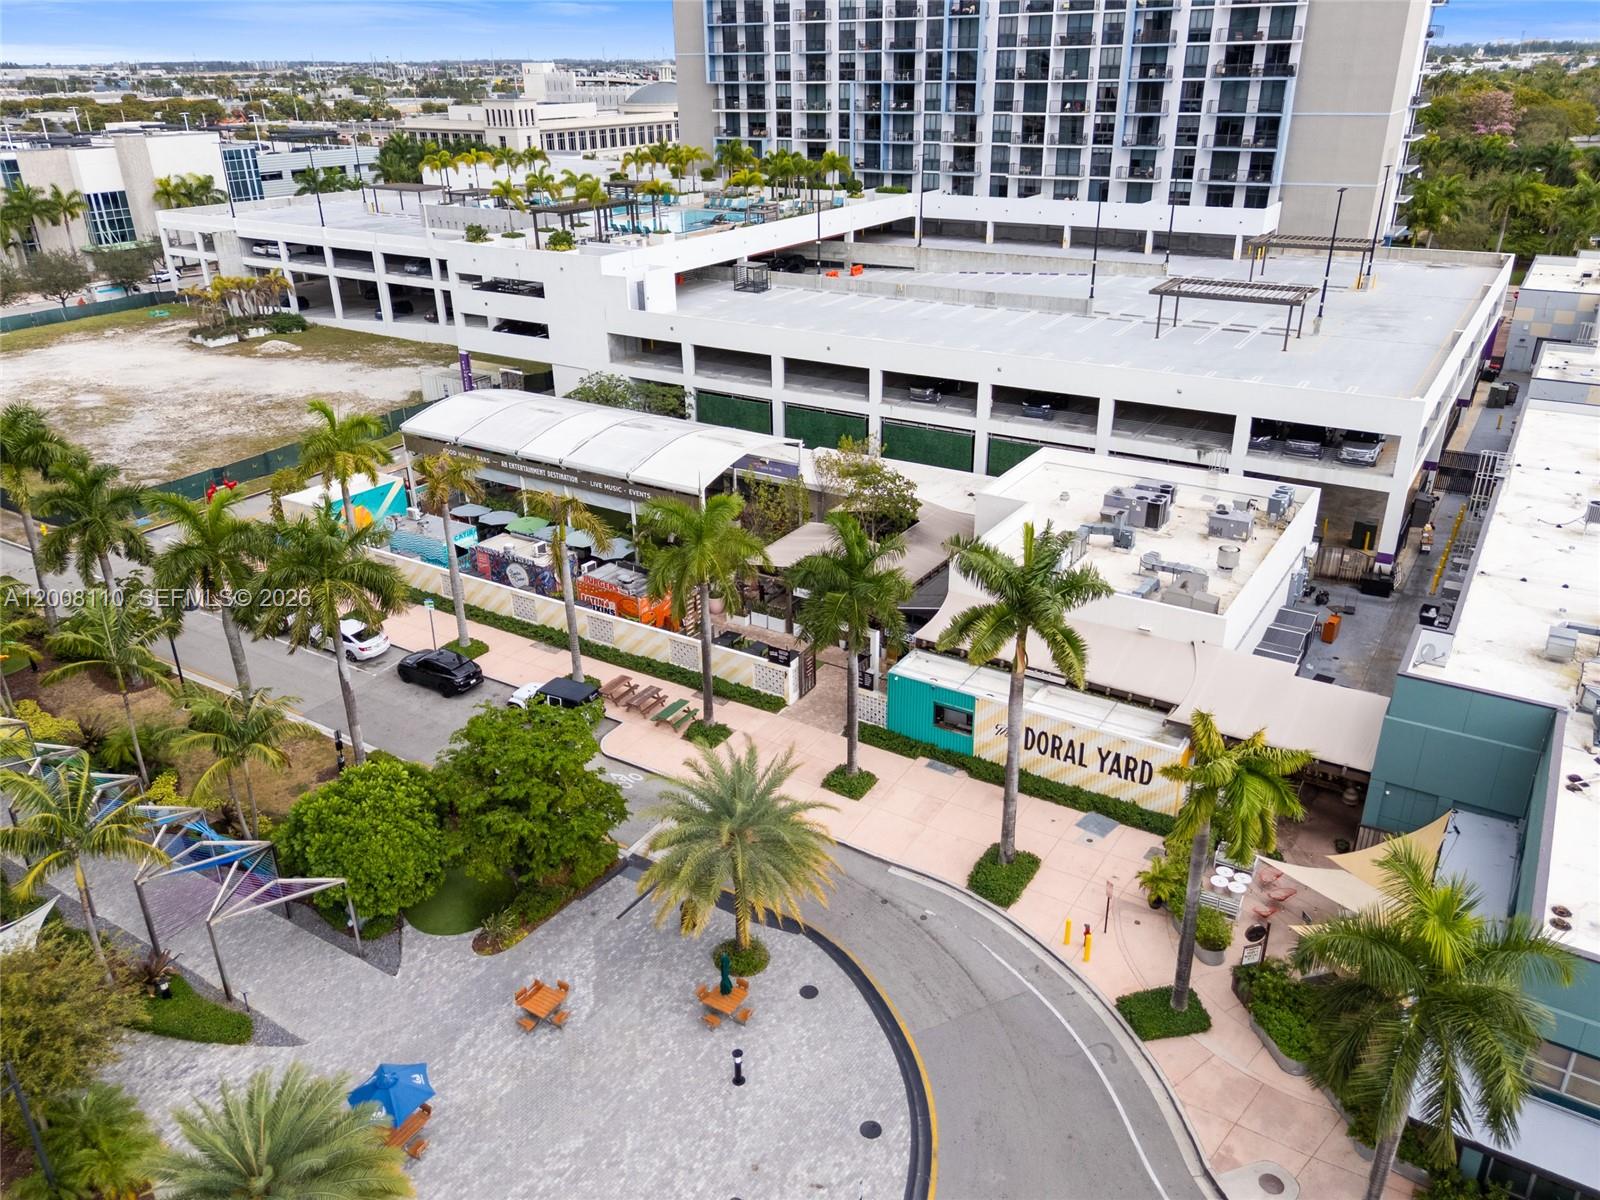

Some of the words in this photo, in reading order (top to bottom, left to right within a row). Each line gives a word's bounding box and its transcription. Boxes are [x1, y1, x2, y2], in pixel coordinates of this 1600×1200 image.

[508, 462, 546, 477] ENTERTAINMENT
[547, 470, 579, 484] DESTINATION
[590, 480, 603, 489] LIVE
[604, 483, 622, 493] MUSIC
[628, 488, 651, 499] EVENTS
[1024, 727, 1088, 768] DORAL
[1097, 747, 1154, 786] YARD
